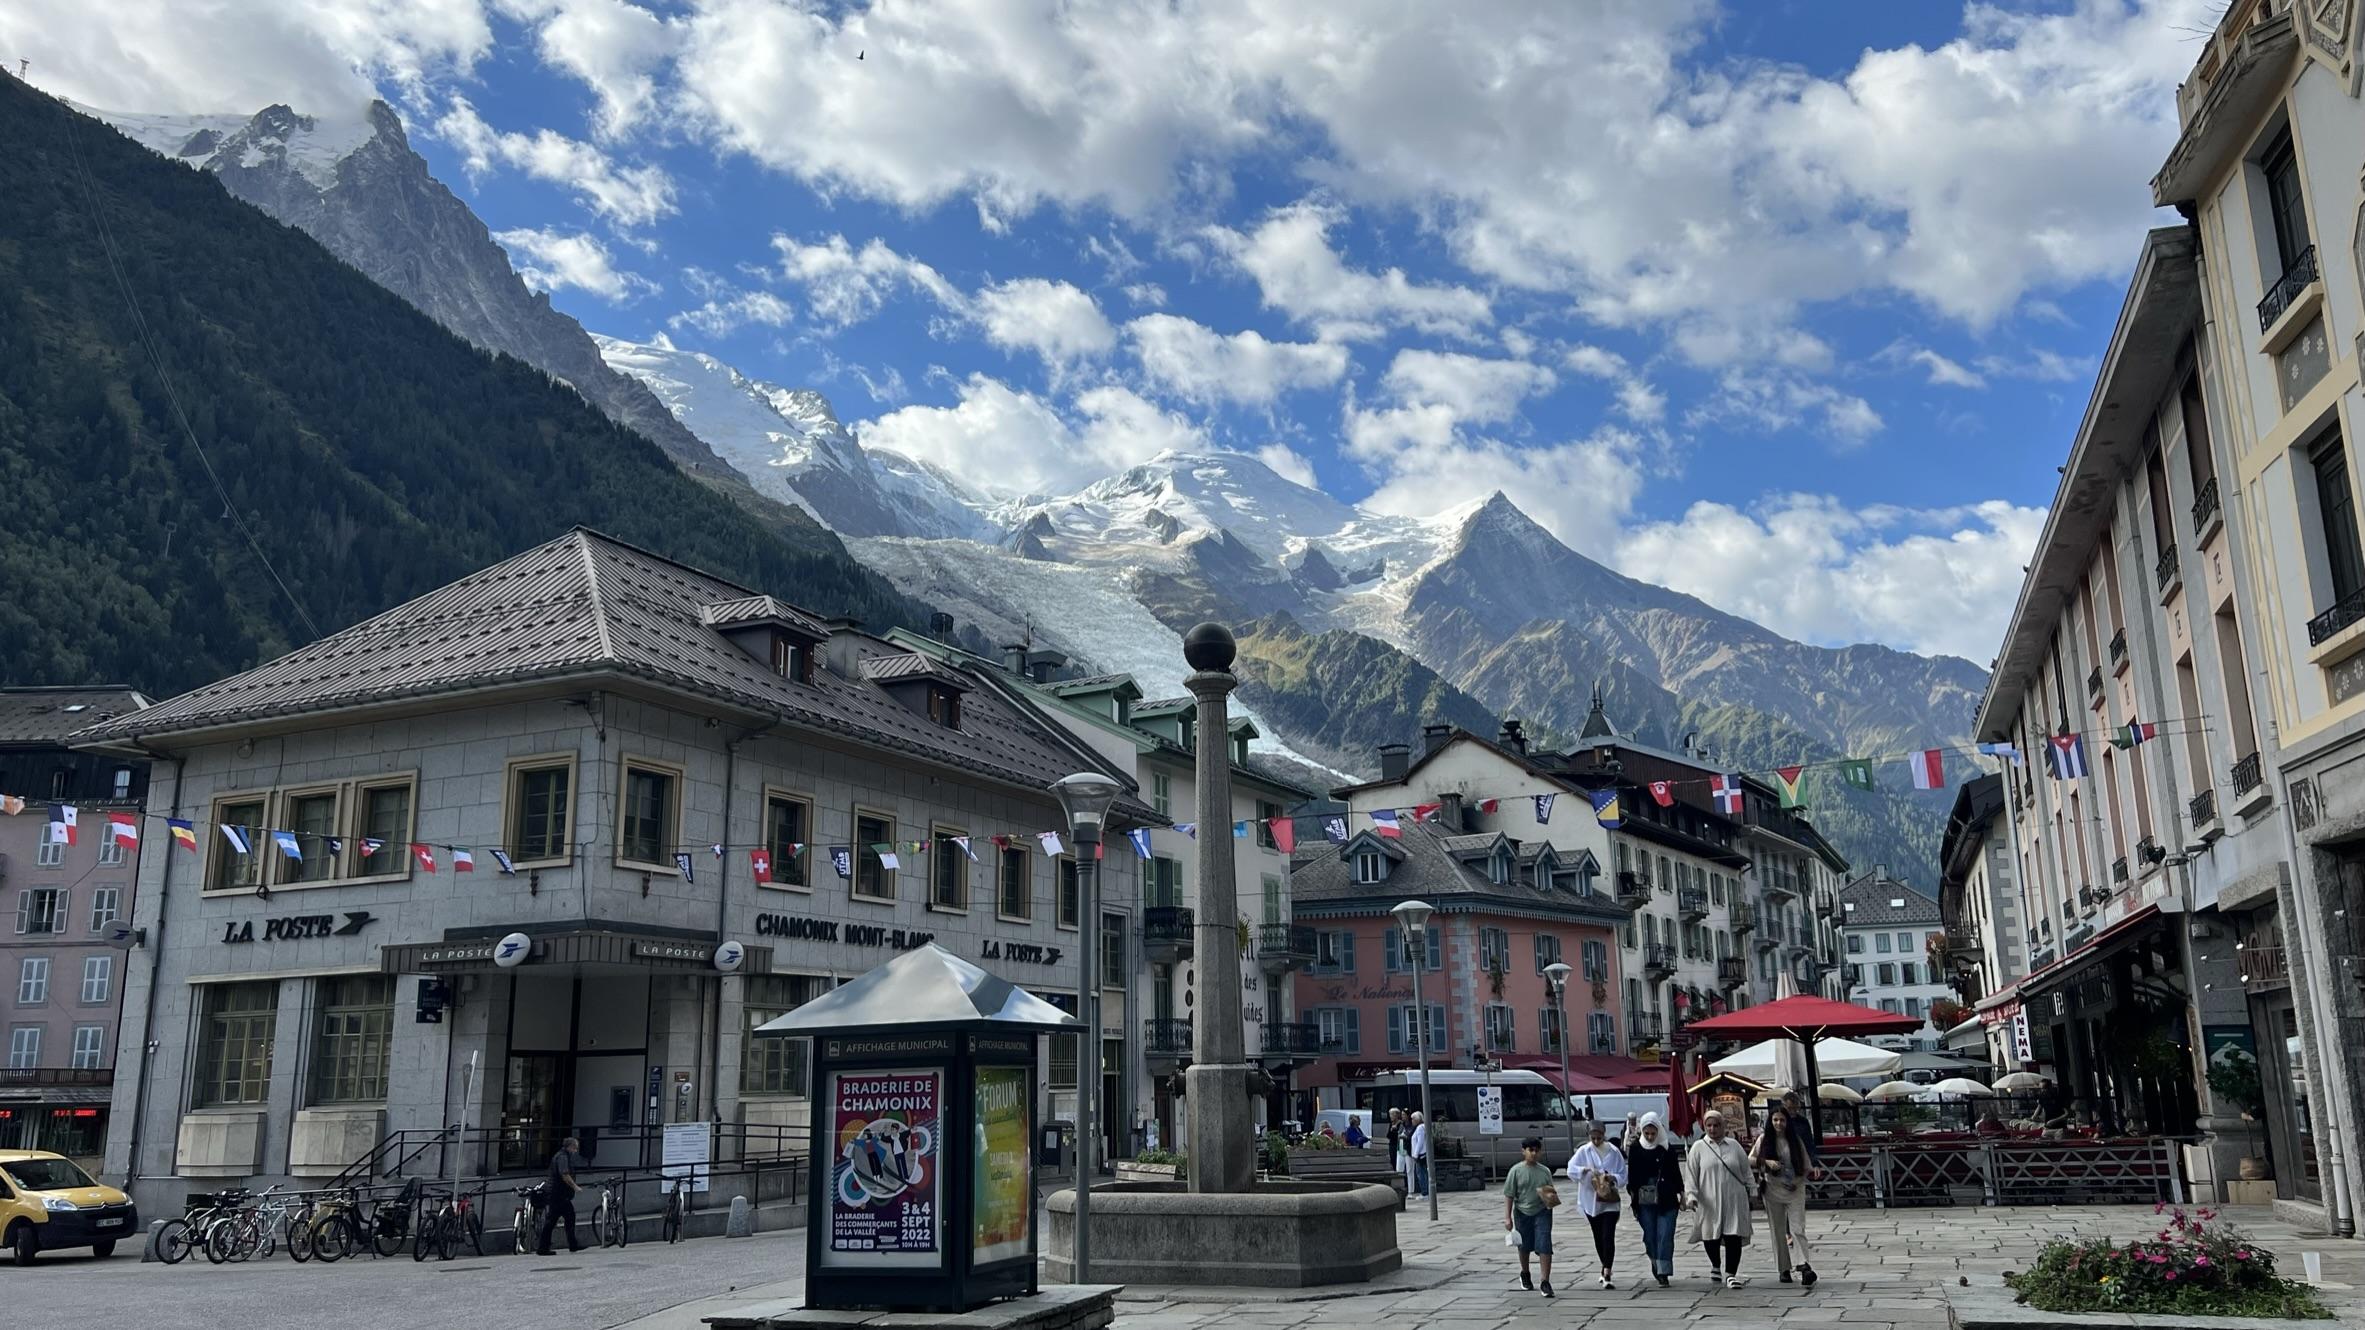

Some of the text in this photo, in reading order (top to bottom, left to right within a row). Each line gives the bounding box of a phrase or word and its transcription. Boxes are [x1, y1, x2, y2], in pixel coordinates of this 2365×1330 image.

[838, 852, 846, 875] UTMB
[221, 915, 333, 943] LA POSTE
[756, 913, 839, 942] CHAMONIX
[423, 948, 492, 960] LA POSTE
[643, 946, 705, 958] LA POSTE
[981, 939, 1043, 964] LA POSTE
[1243, 1001, 1264, 1024] uides
[2016, 1017, 2029, 1057] NEMA
[846, 1039, 949, 1053] AFFICHAGE MUNICIPAL
[843, 1080, 932, 1095] BRADERIE DE
[842, 1096, 932, 1111] CHAMONIX
[983, 1082, 1017, 1112] FORUM
[902, 1201, 930, 1215] 3 & 4
[848, 1221, 897, 1229] COMMERÇANTS
[901, 1216, 931, 1228] SEPT
[853, 1227, 876, 1236] VALLÉE
[901, 1229, 931, 1240] 2022
